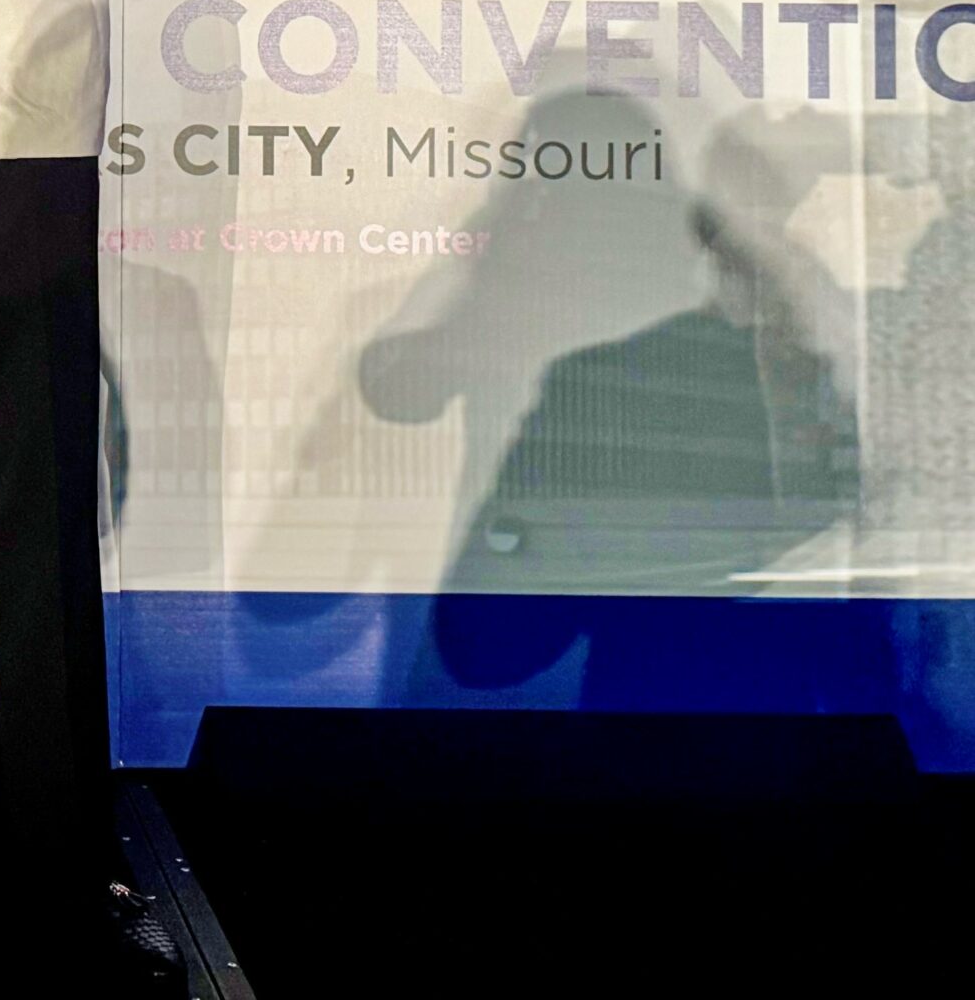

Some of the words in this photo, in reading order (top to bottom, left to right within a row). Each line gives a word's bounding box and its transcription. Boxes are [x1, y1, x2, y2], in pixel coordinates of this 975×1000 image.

[172, 123, 355, 186] CITY,
[386, 126, 662, 181] Missouri
[168, 223, 206, 252] at
[219, 222, 345, 254] Crown
[359, 223, 491, 255] Center
